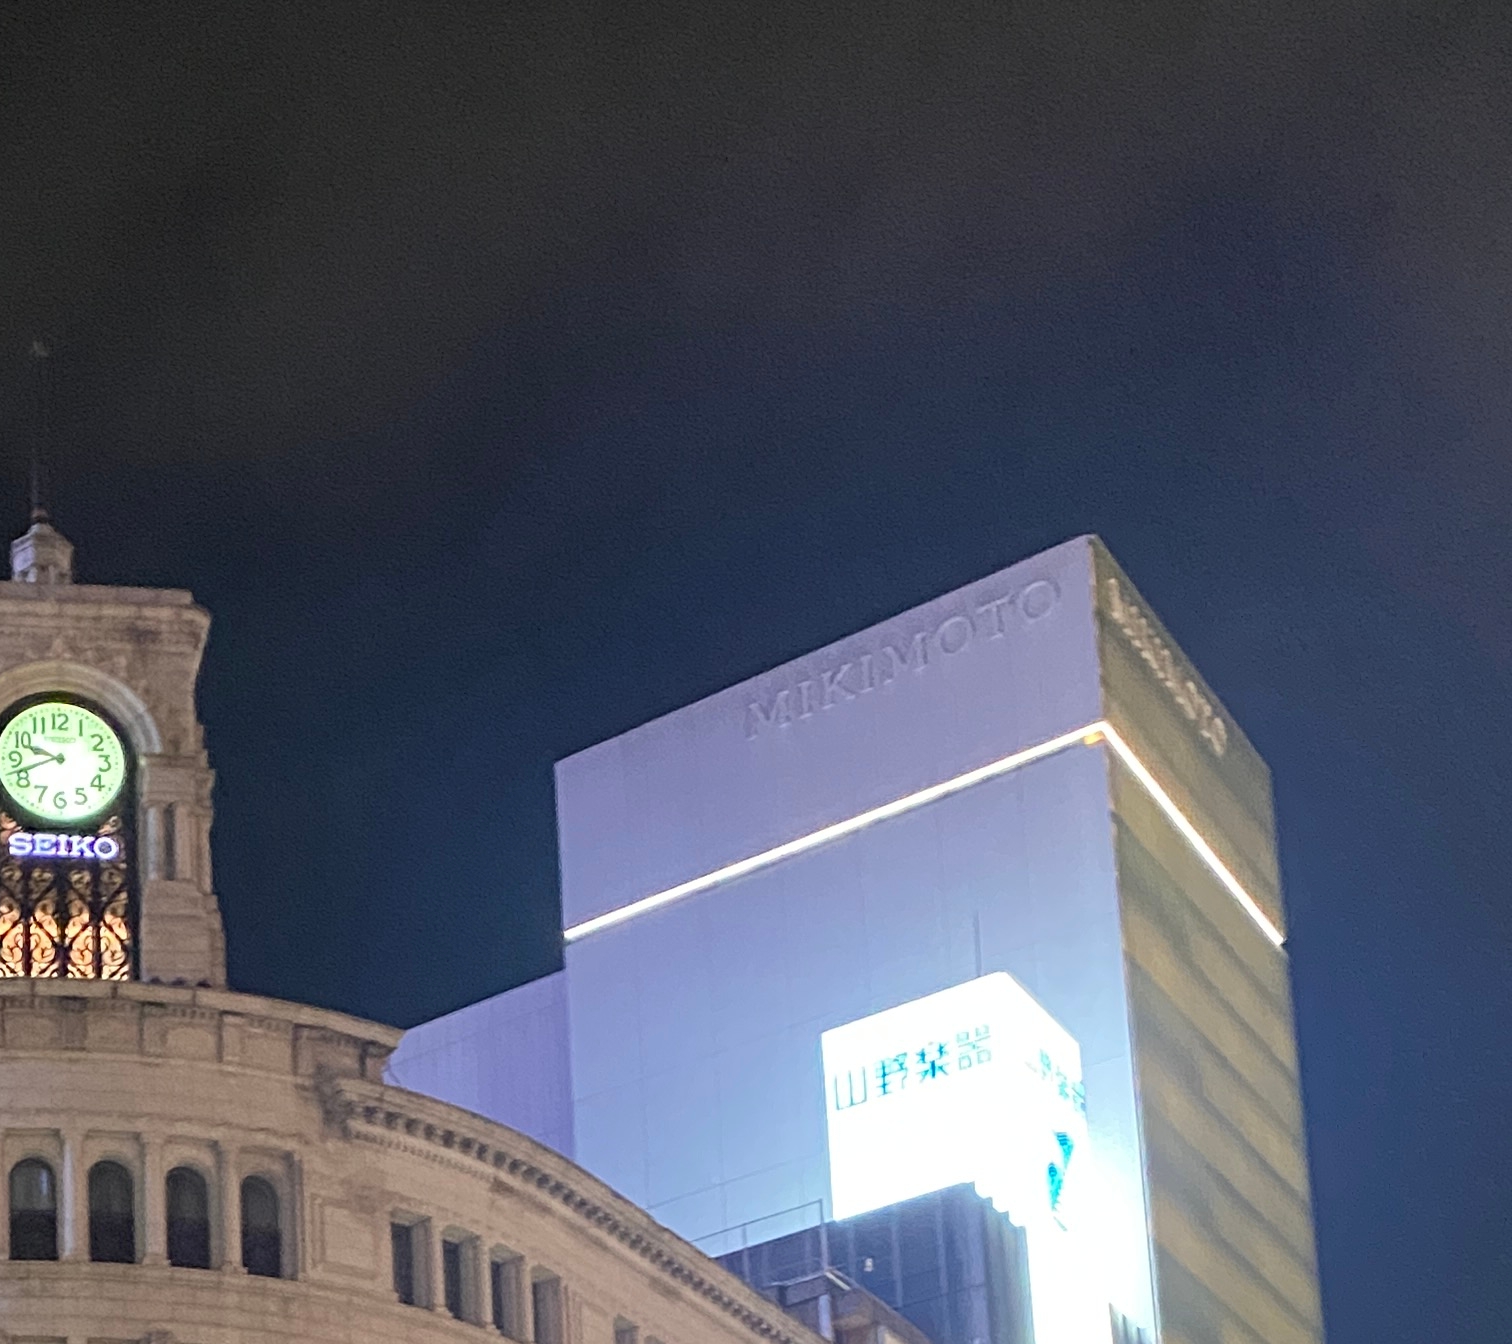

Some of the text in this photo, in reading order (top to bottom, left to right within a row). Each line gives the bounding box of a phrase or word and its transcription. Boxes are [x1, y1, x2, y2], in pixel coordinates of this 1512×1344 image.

[742, 579, 1062, 741] MIKIMOTO
[32, 717, 45, 734] 11
[51, 713, 69, 731] 12
[78, 719, 84, 736] 1
[15, 731, 31, 749] 10
[90, 734, 104, 751] 2
[8, 751, 22, 768] 9
[98, 755, 112, 772] 3
[16, 770, 30, 788] 8
[90, 774, 105, 791] 4
[34, 785, 48, 803] 7
[53, 791, 67, 809] 6
[74, 788, 88, 805] 5
[8, 832, 119, 860] SEIKO
